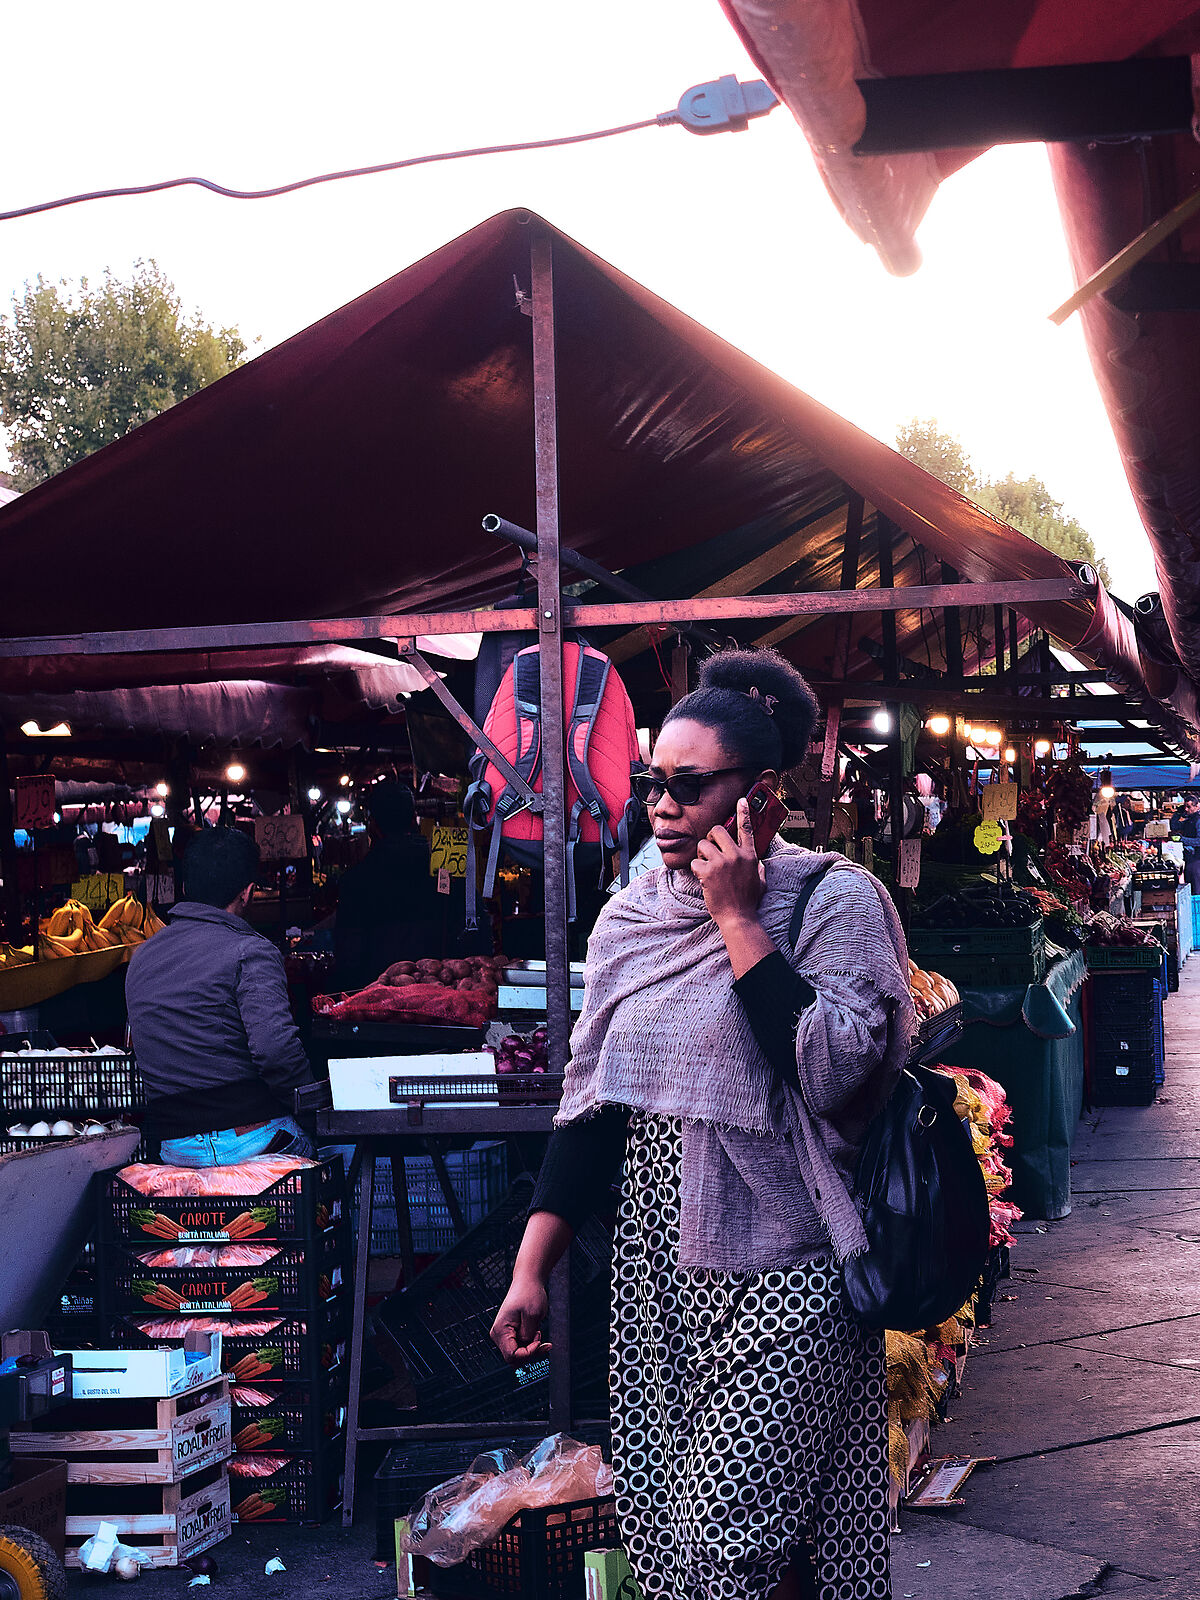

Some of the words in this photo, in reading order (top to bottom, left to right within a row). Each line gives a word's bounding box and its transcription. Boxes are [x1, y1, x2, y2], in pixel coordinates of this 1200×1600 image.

[179, 1212, 226, 1226] CAROTE
[181, 1282, 228, 1296] CAROTE
[177, 1434, 202, 1460] ROYAL
